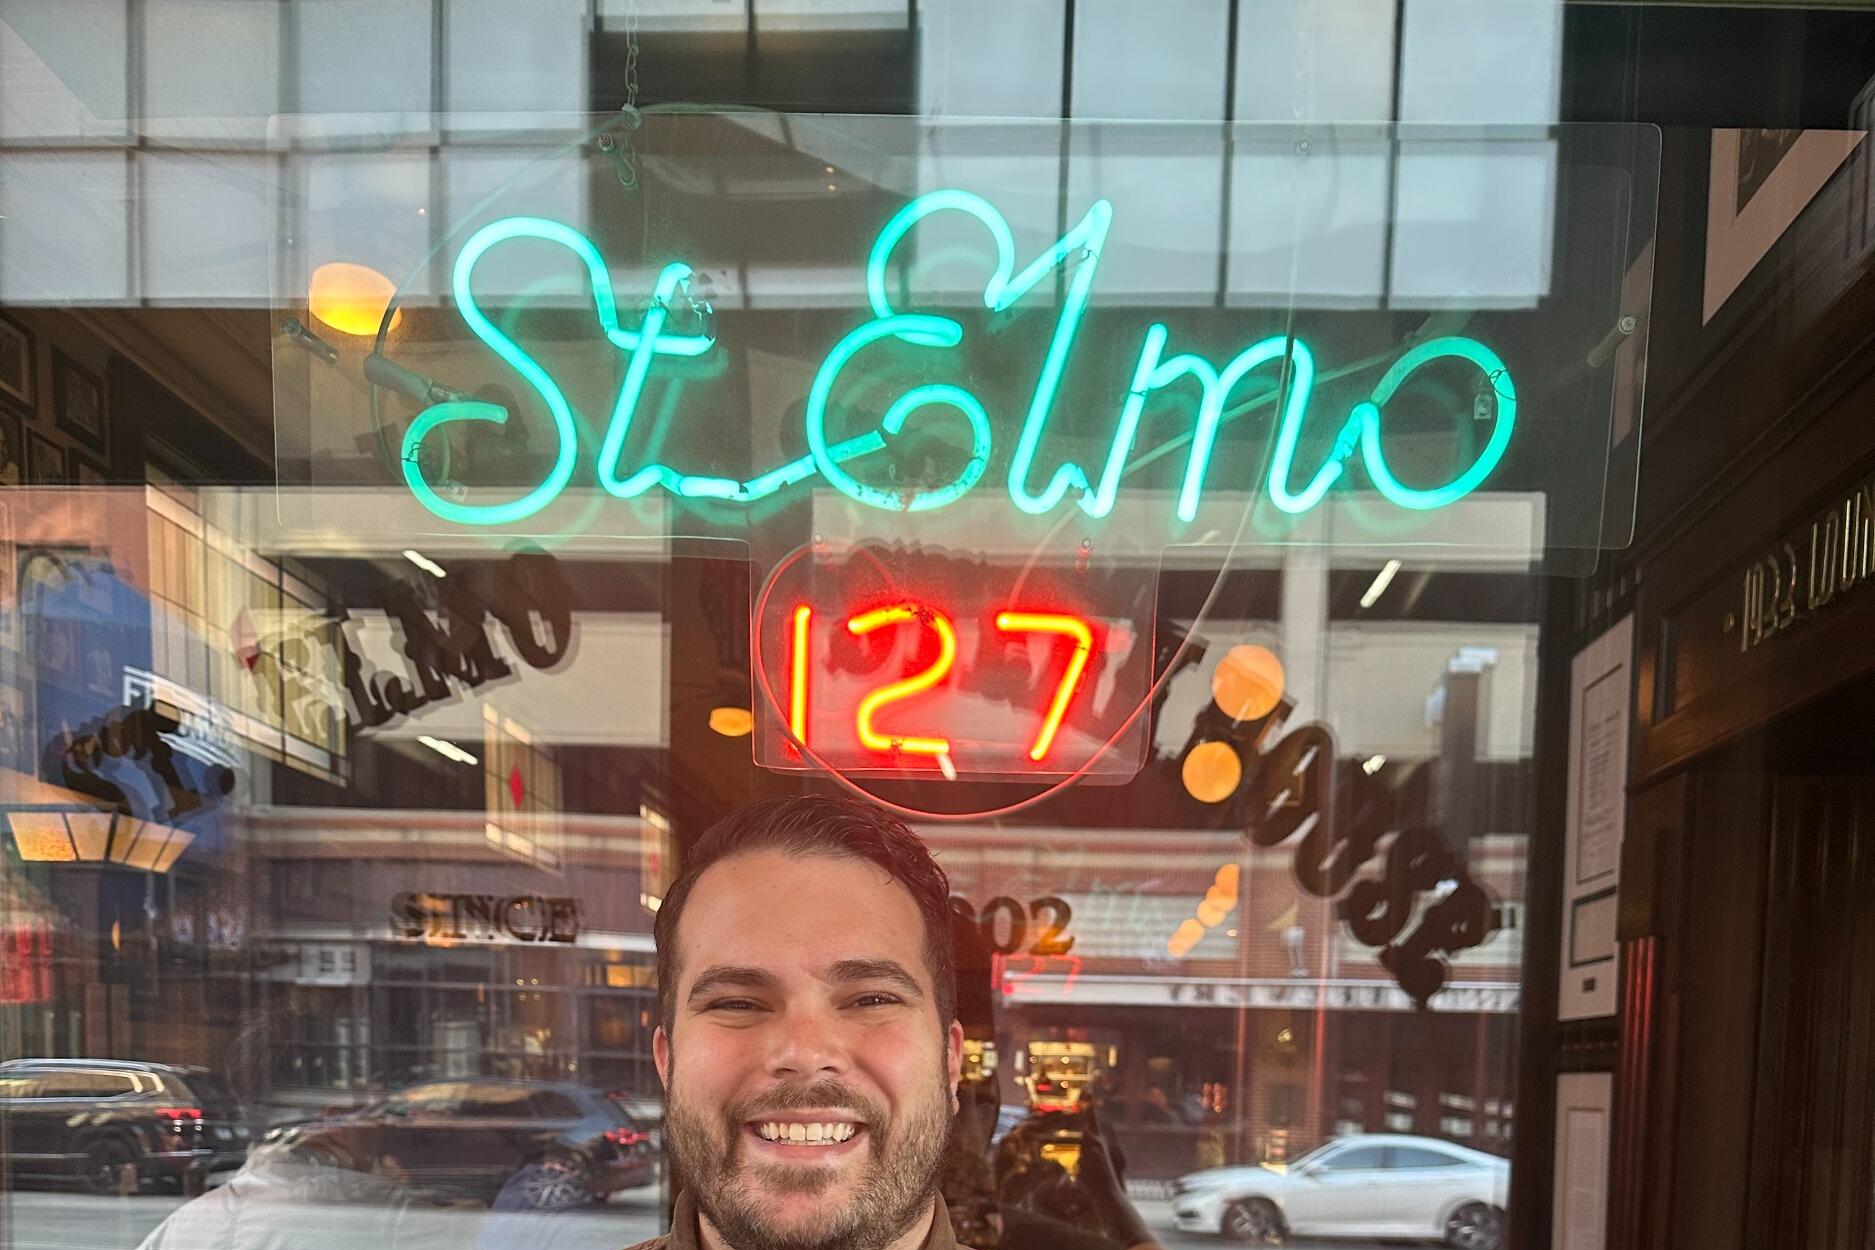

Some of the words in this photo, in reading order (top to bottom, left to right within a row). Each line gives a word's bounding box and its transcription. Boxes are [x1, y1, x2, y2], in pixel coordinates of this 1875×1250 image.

[400, 214, 722, 526] St
[805, 188, 1518, 522] Elmo
[788, 604, 1093, 764] 127
[390, 891, 585, 943] SINCE
[948, 896, 1075, 955] 02
